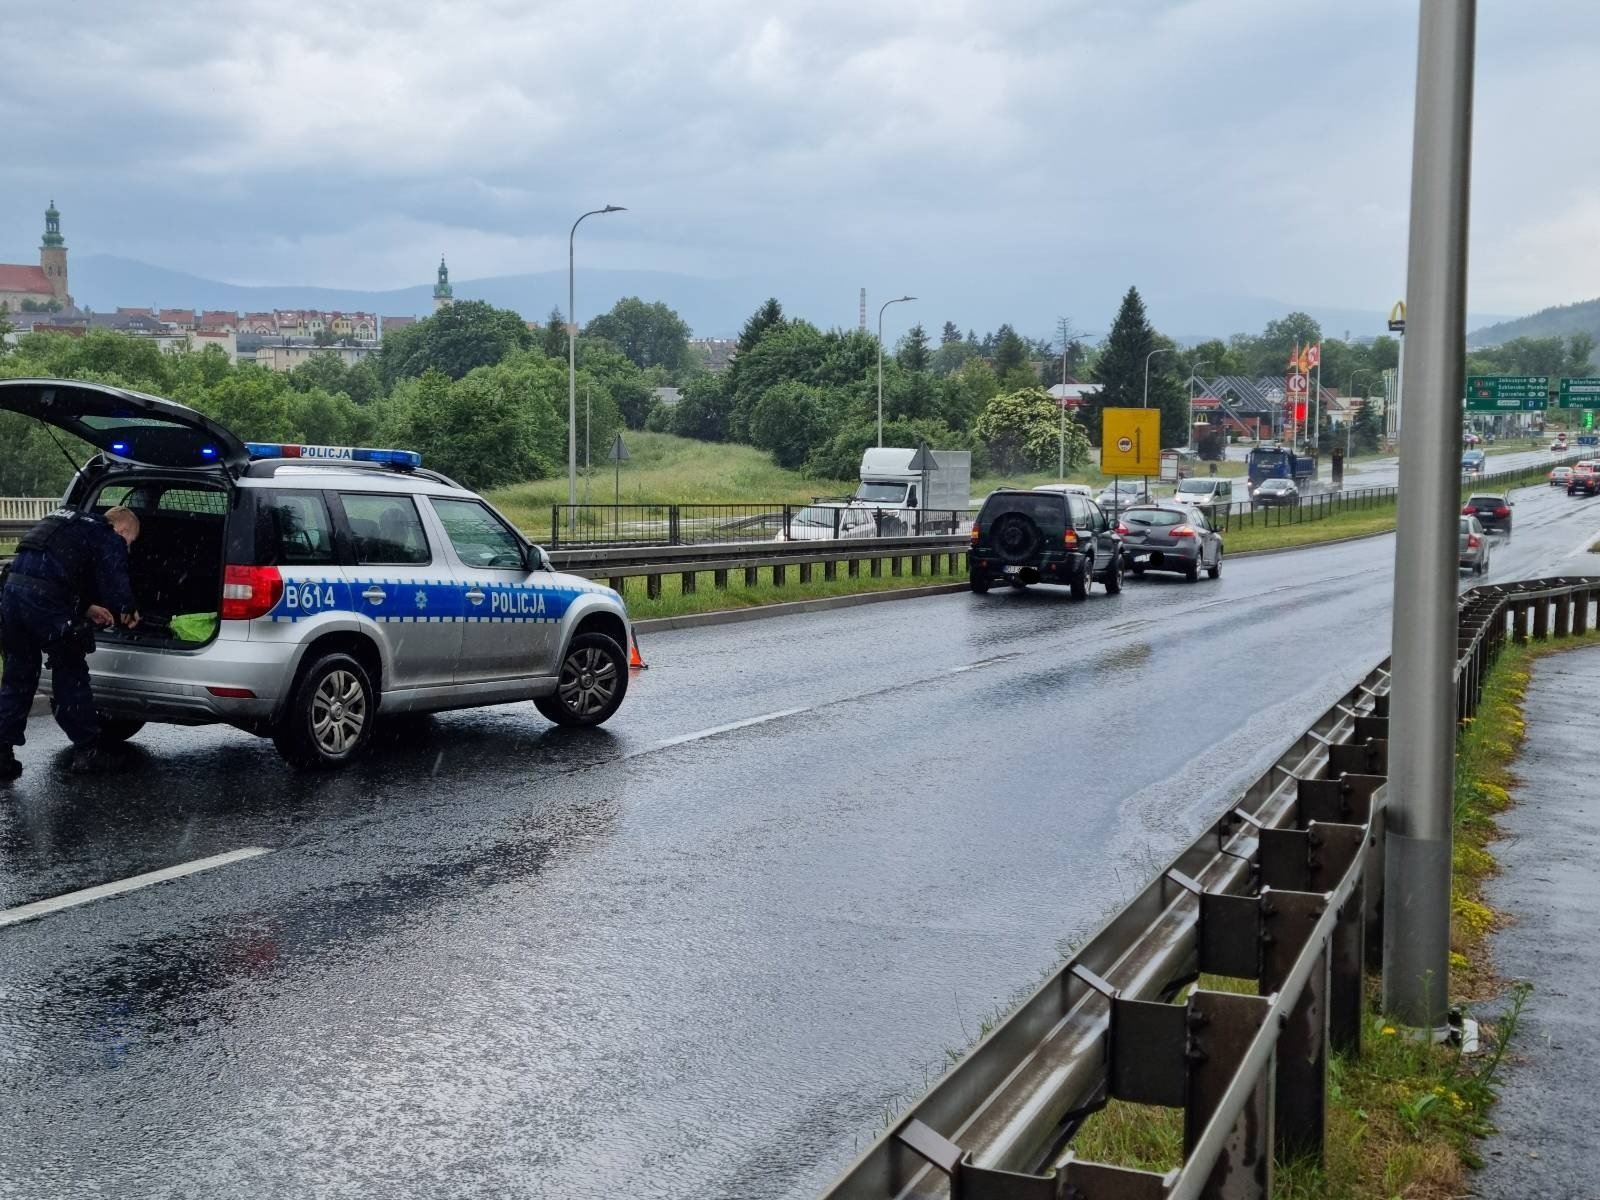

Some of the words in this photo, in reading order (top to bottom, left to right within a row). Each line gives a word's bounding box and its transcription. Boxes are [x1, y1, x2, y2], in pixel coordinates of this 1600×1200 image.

[300, 446, 351, 459] POLICJA
[286, 585, 336, 609] B614
[491, 591, 546, 614] POLICJA
